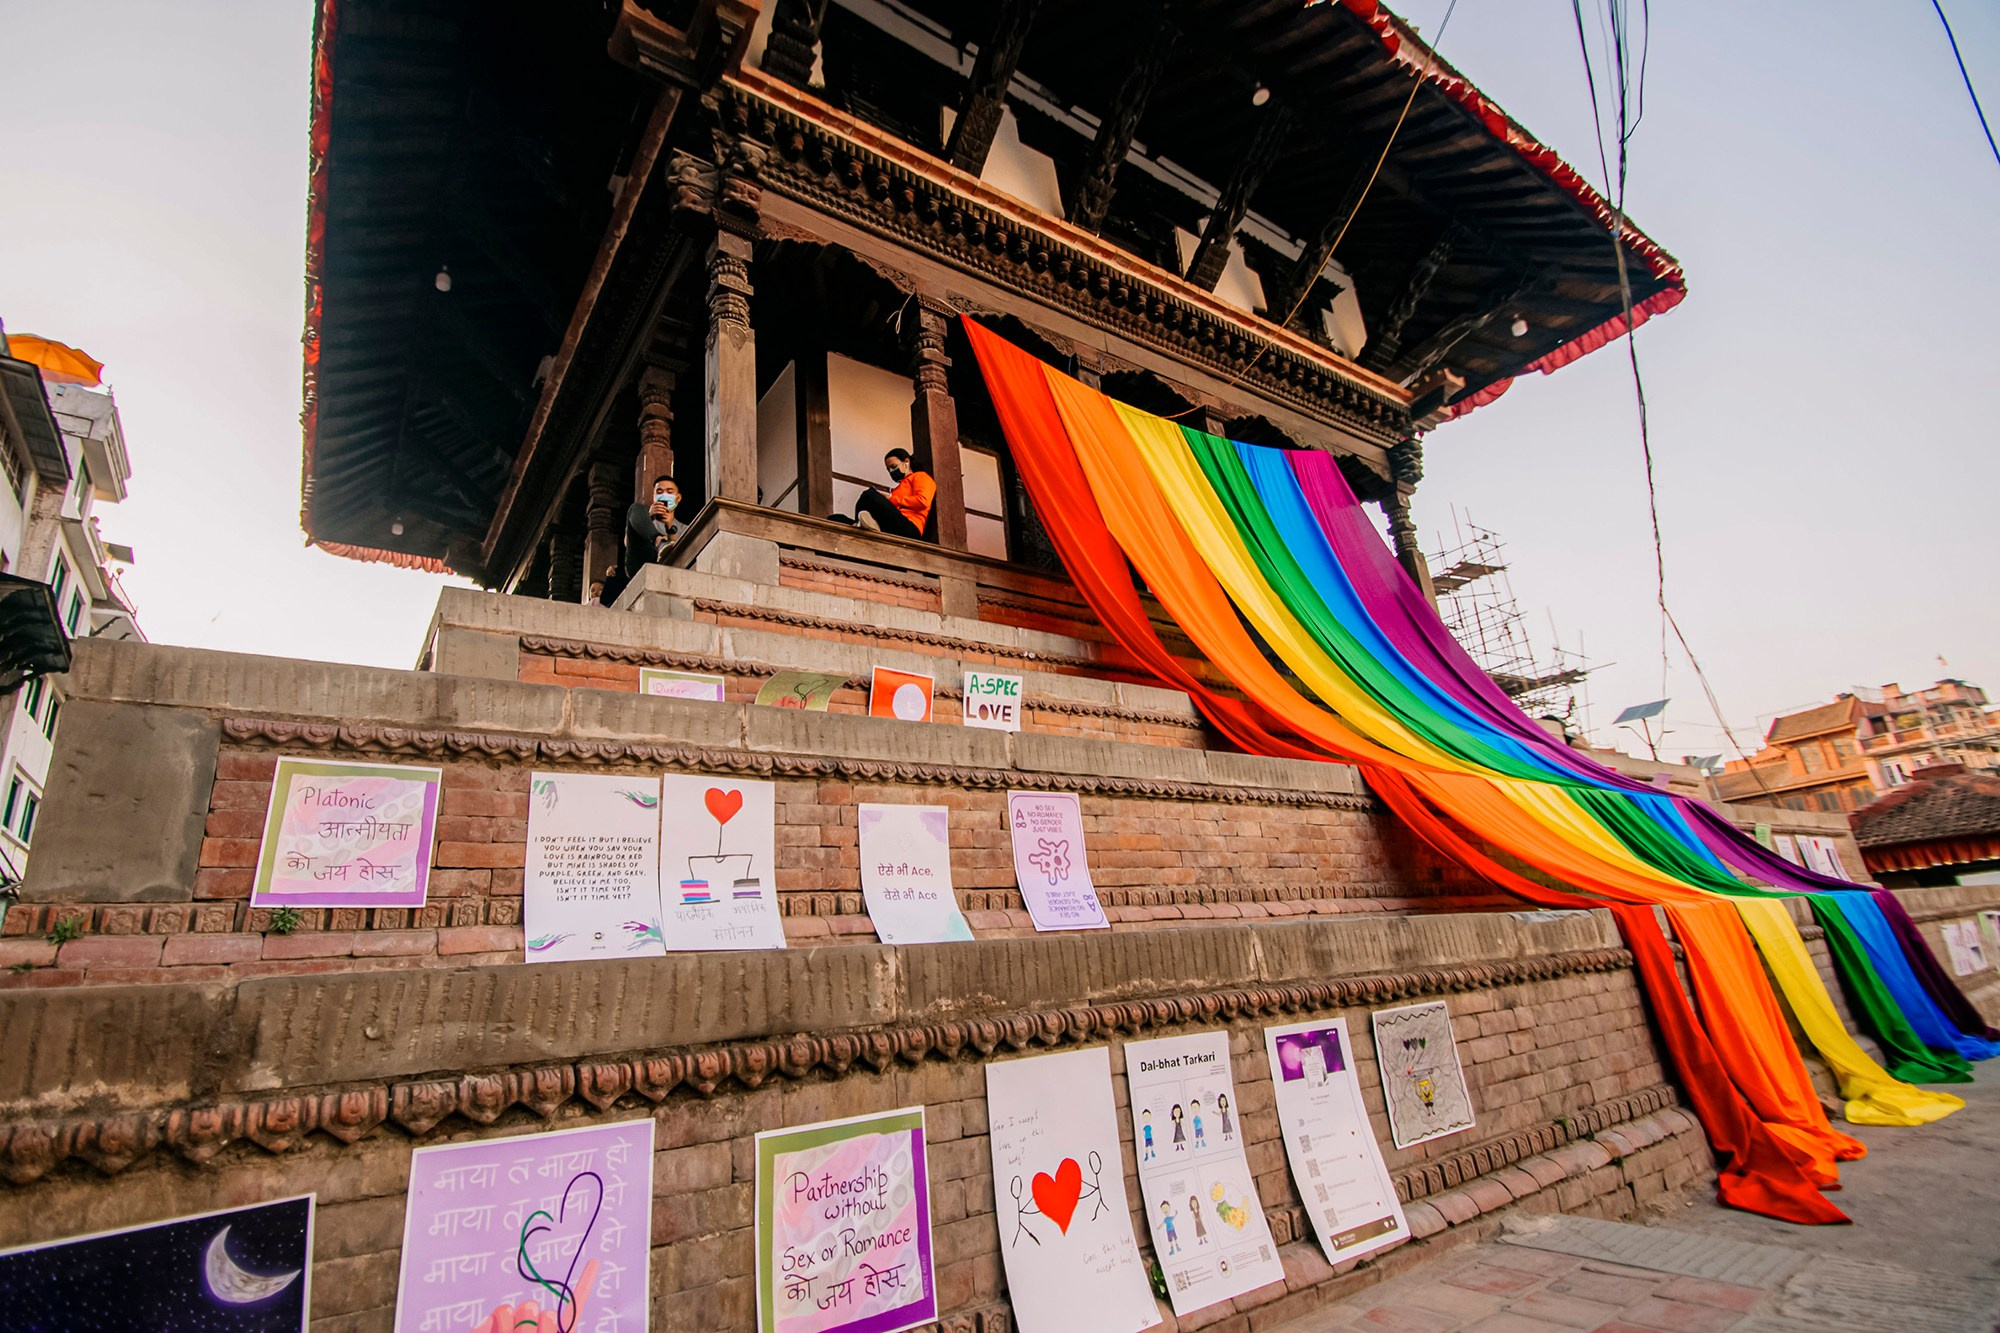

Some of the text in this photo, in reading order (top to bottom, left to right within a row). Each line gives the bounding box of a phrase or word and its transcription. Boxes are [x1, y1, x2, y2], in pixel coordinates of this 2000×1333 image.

[969, 674, 1019, 696] A-SPEC
[965, 696, 1012, 722] LOVE
[297, 786, 376, 810] Platonic
[318, 815, 413, 841] आत्मीयता
[1016, 809, 1024, 820] A
[286, 851, 318, 870] को
[314, 865, 352, 881] जय
[897, 862, 908, 876] भी
[911, 866, 934, 877] Ace,
[903, 886, 915, 900] भी
[918, 891, 937, 900] Ace
[1087, 902, 1096, 912] A
[1140, 1051, 1216, 1073] Dal-bhat Tarkari
[433, 1137, 632, 1192] माया त माया हो
[784, 1164, 888, 1203] Partnership
[824, 1190, 888, 1220] without
[428, 1205, 498, 1236] माया
[424, 1252, 496, 1284] माया
[599, 1217, 628, 1252] हो
[781, 1228, 912, 1272] Sex or Romance
[597, 1261, 627, 1299] हो
[784, 1273, 818, 1302] को
[817, 1279, 856, 1310] जय
